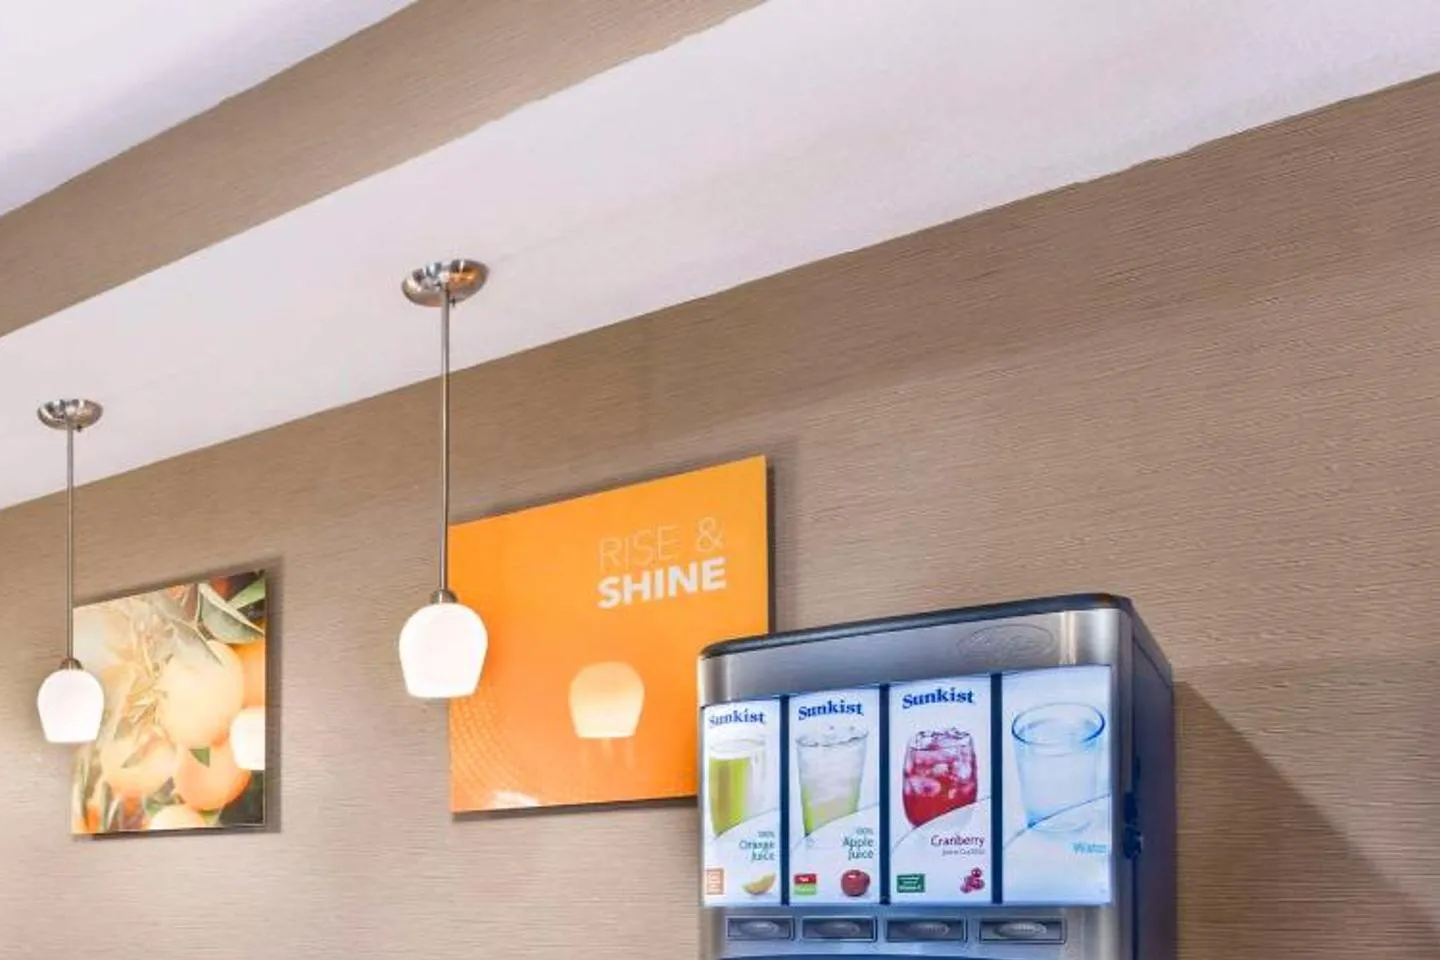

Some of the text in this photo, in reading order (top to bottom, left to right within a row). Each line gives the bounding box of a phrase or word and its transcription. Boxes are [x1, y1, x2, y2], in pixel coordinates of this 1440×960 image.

[599, 516, 724, 573] RISE &
[597, 556, 727, 610] SHINE
[902, 686, 975, 710] Sunkist
[708, 708, 766, 728] Sunkist
[798, 699, 864, 721] Sunkist
[930, 833, 985, 848] Cranberry
